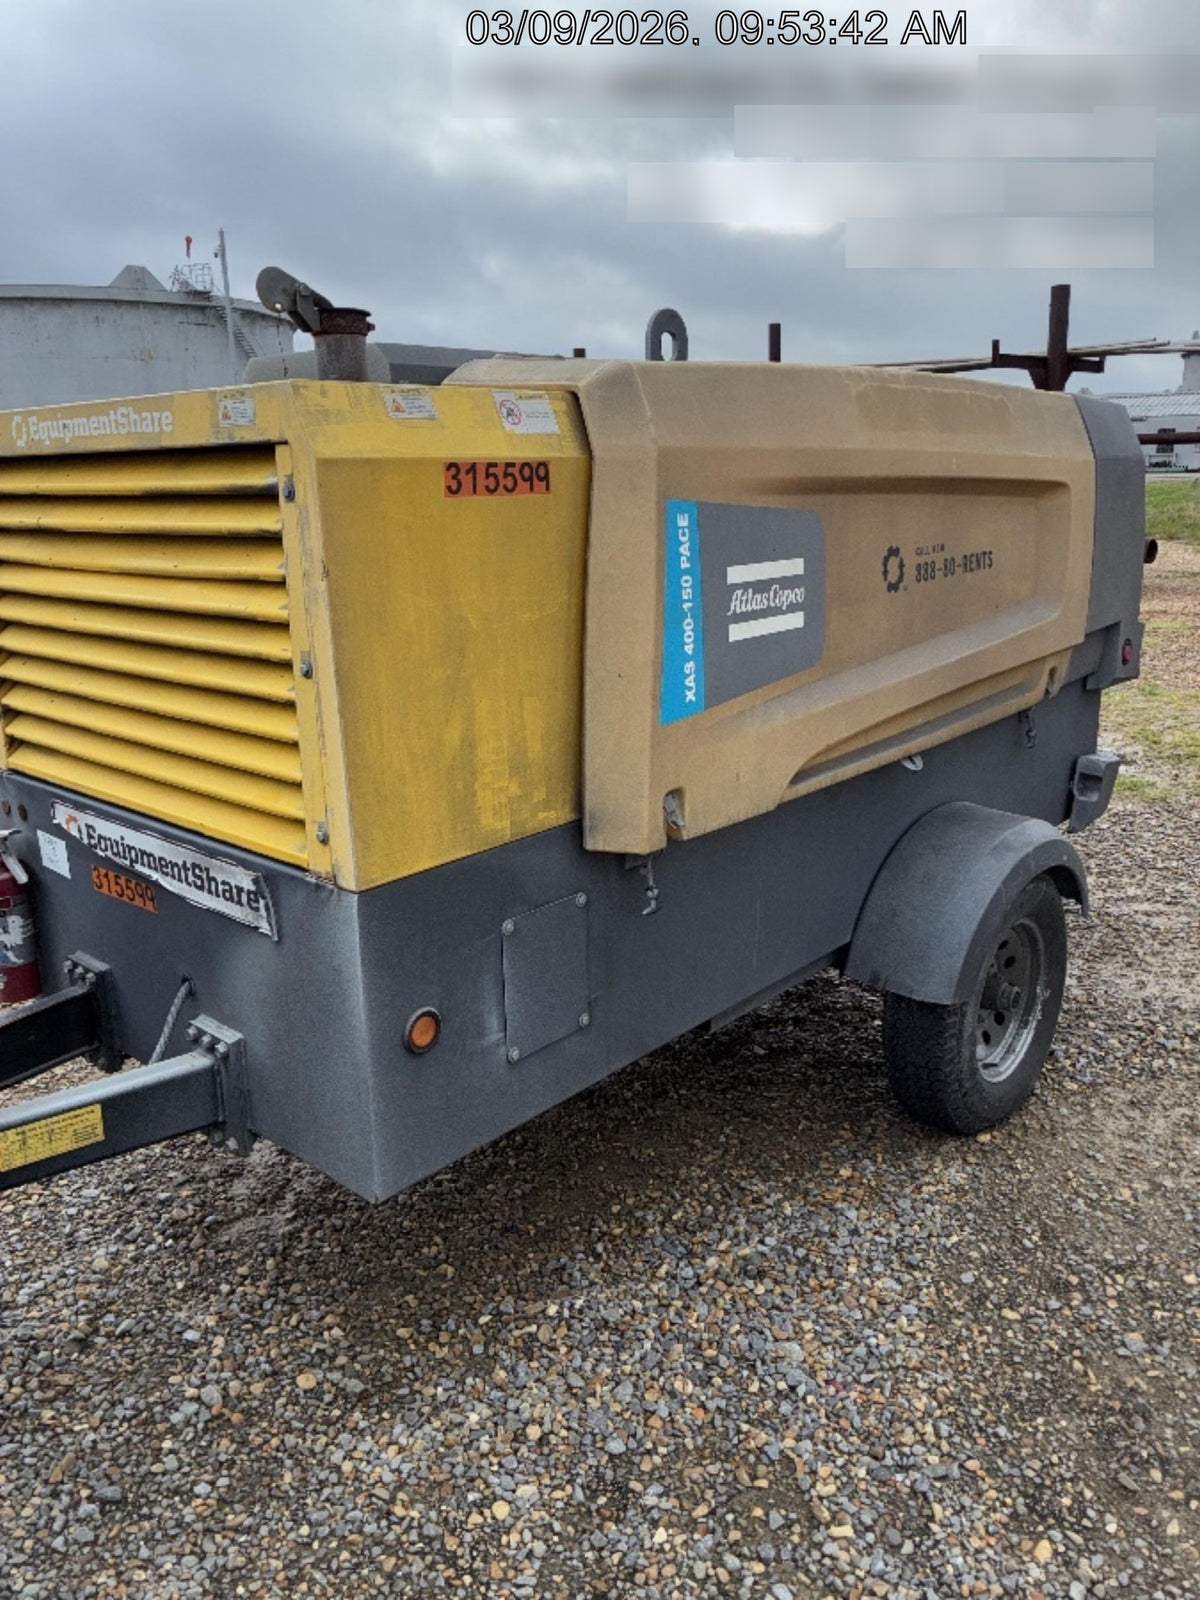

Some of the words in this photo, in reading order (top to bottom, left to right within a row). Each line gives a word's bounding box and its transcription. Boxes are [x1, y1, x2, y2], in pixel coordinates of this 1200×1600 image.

[28, 406, 173, 444] EquipmentShare
[446, 461, 550, 495] 315599
[676, 512, 691, 570] PACE
[680, 574, 695, 656] 400-150
[727, 587, 768, 616] Atlas
[768, 583, 805, 609] Copco
[685, 660, 697, 703] XAS
[92, 866, 156, 908] 315599
